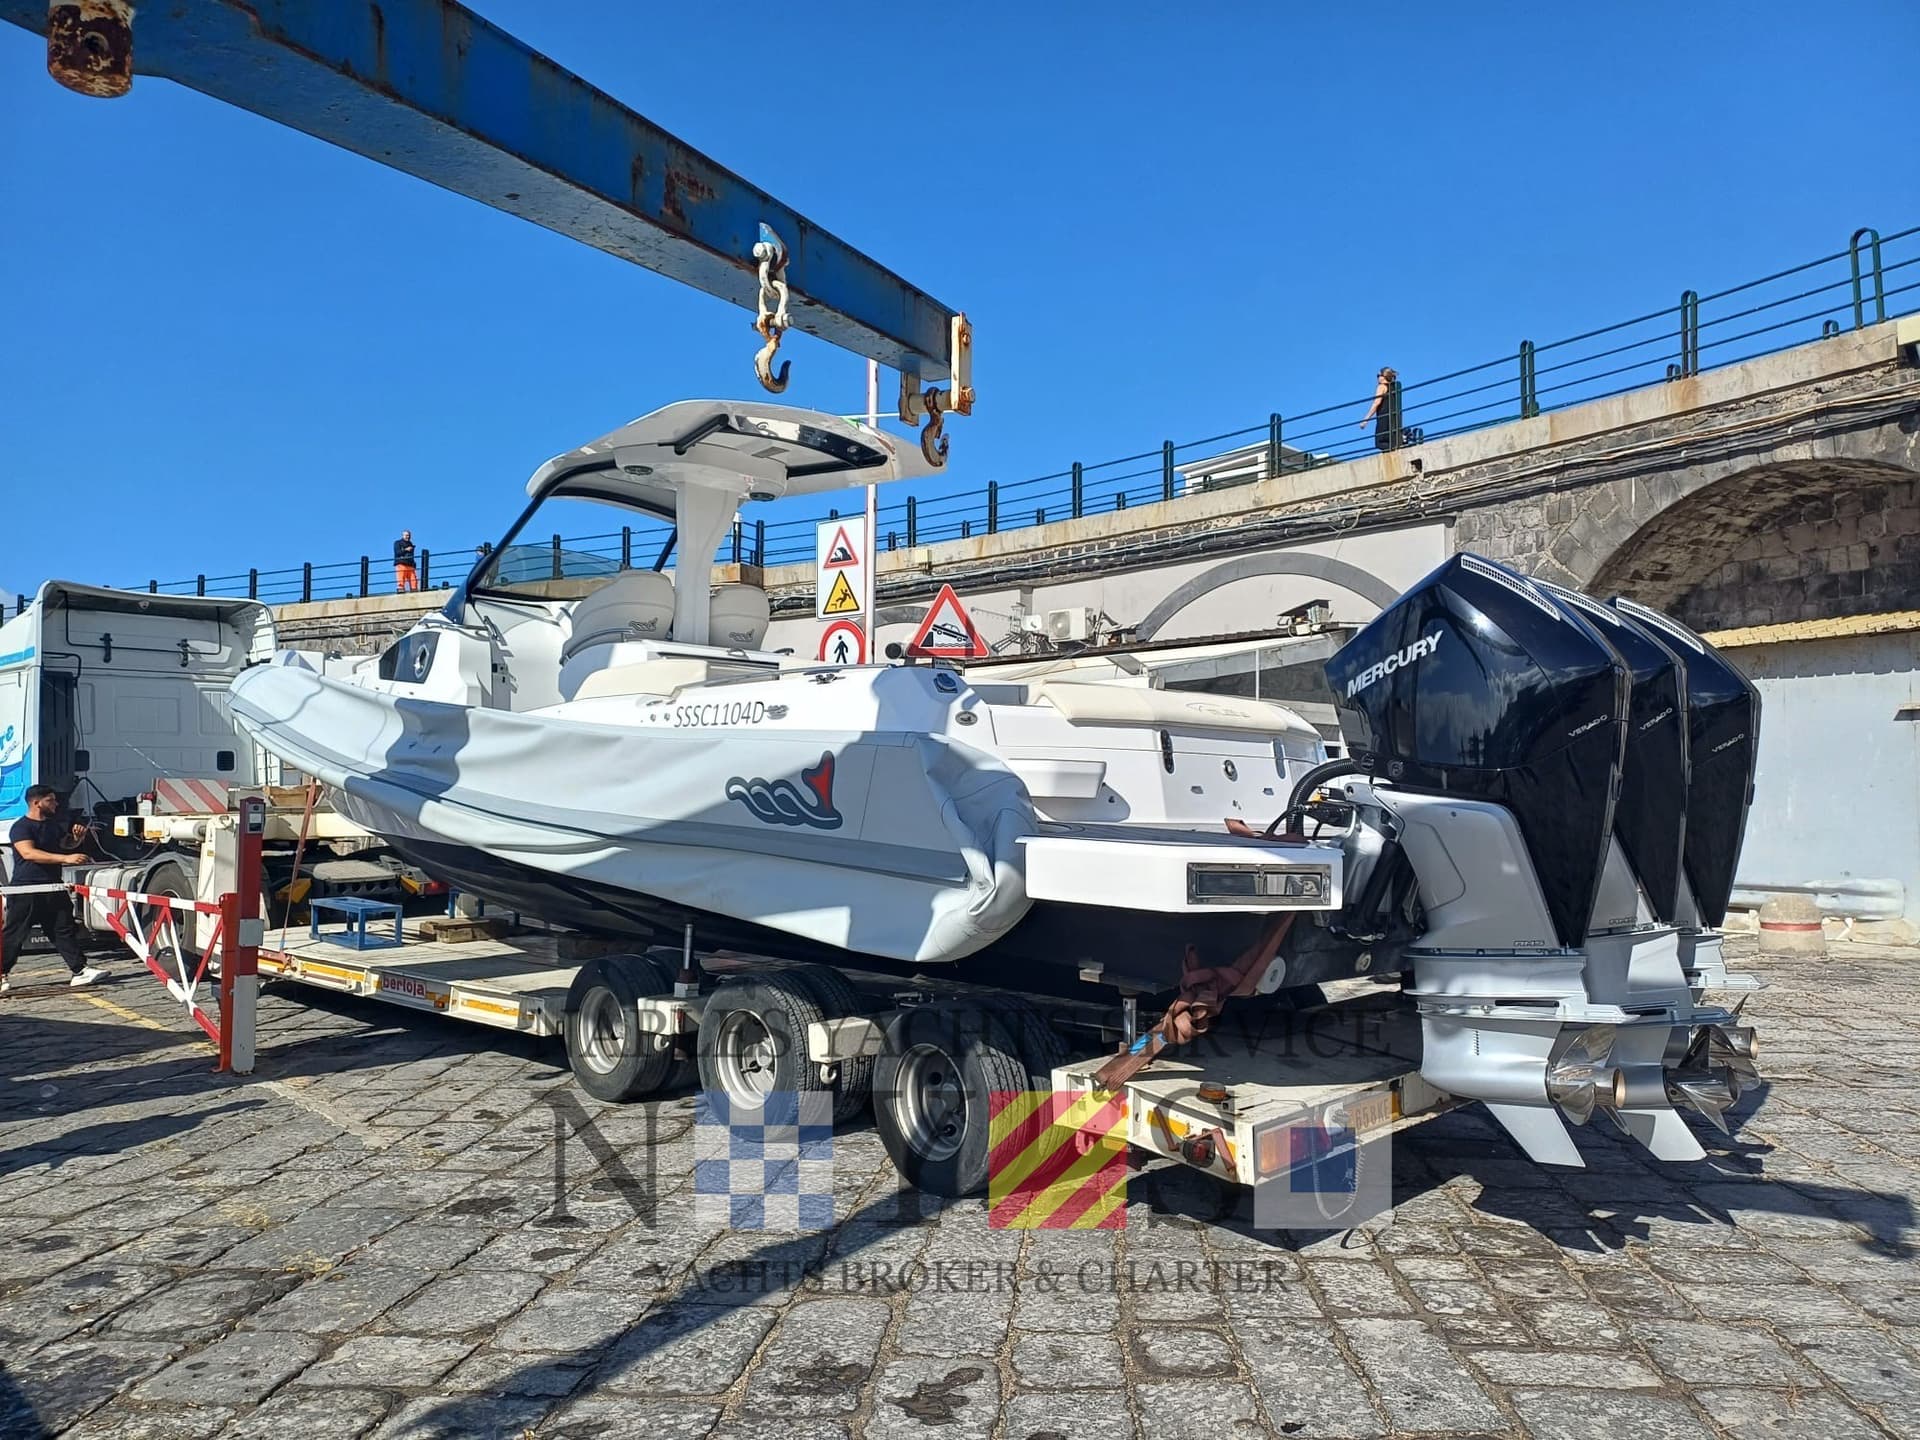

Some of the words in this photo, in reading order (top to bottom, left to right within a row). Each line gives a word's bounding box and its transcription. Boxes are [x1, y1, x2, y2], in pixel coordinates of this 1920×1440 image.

[1347, 630, 1443, 698] MERCURY
[674, 701, 765, 728] SSSC1104D
[1568, 714, 1608, 737] VERADO
[1711, 733, 1745, 752] VERADO
